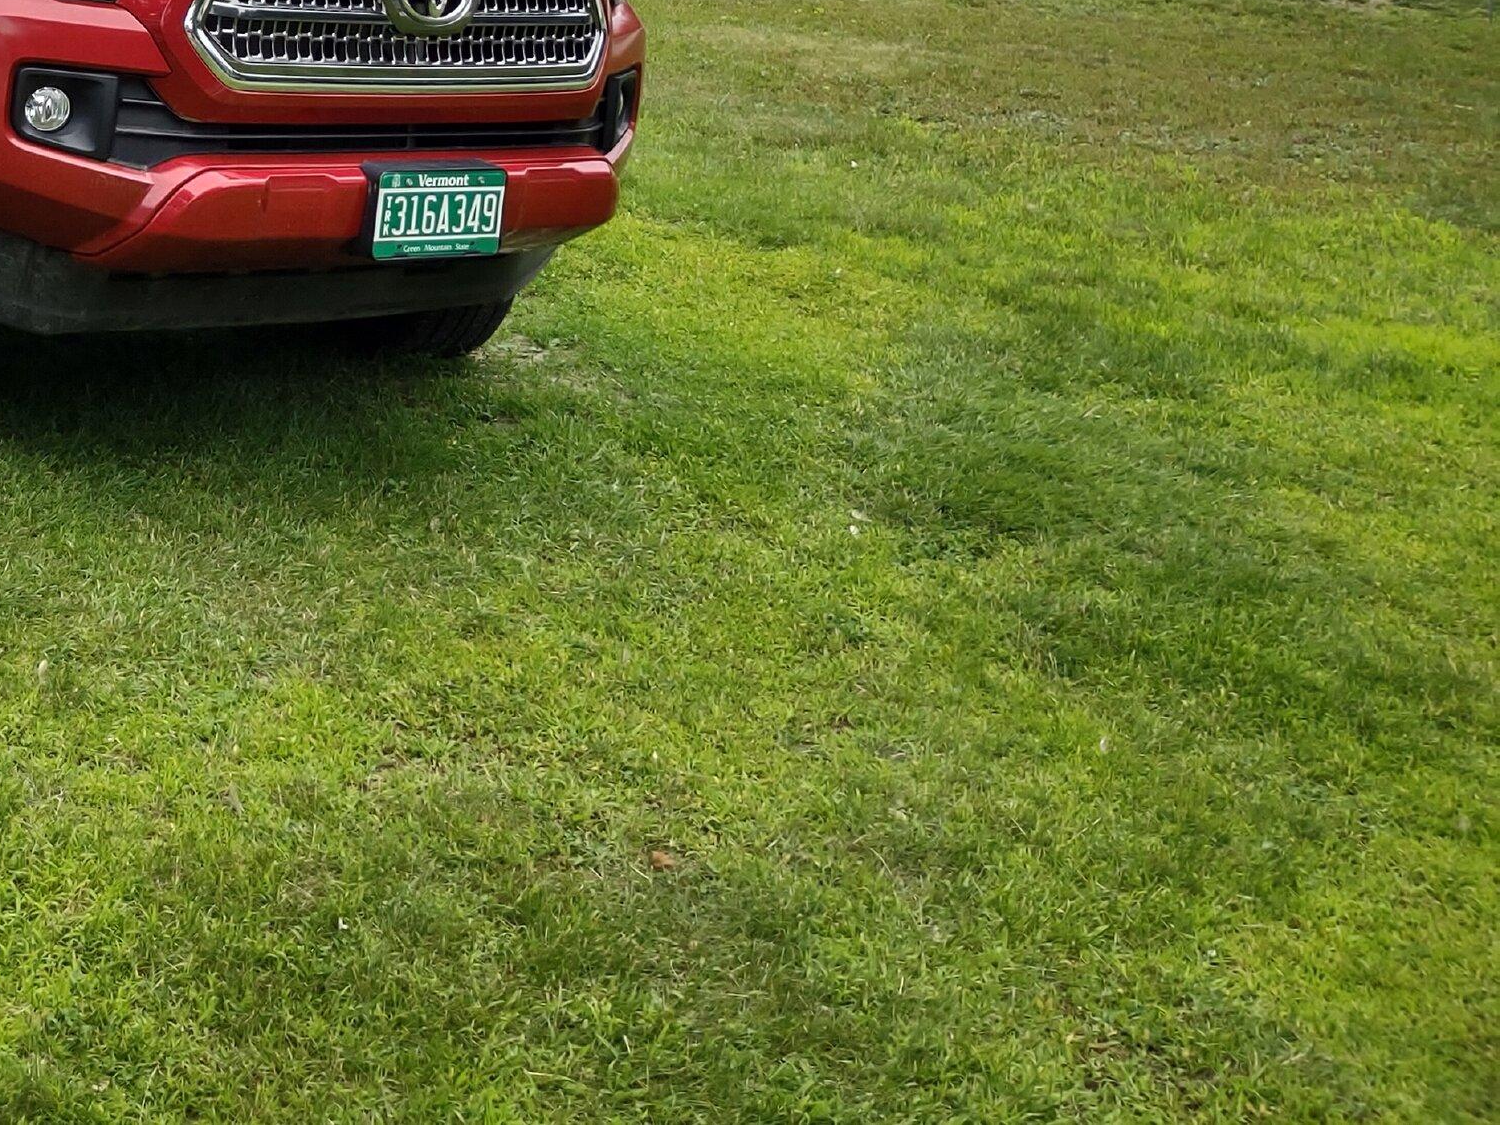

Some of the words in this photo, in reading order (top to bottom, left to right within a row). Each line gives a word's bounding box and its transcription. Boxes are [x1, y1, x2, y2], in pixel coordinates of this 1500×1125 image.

[418, 174, 470, 187] Vermont
[383, 196, 393, 236] TRK
[391, 193, 498, 236] 316A349
[403, 244, 421, 253] Green
[424, 242, 453, 252] Mountain
[454, 243, 470, 251] State
